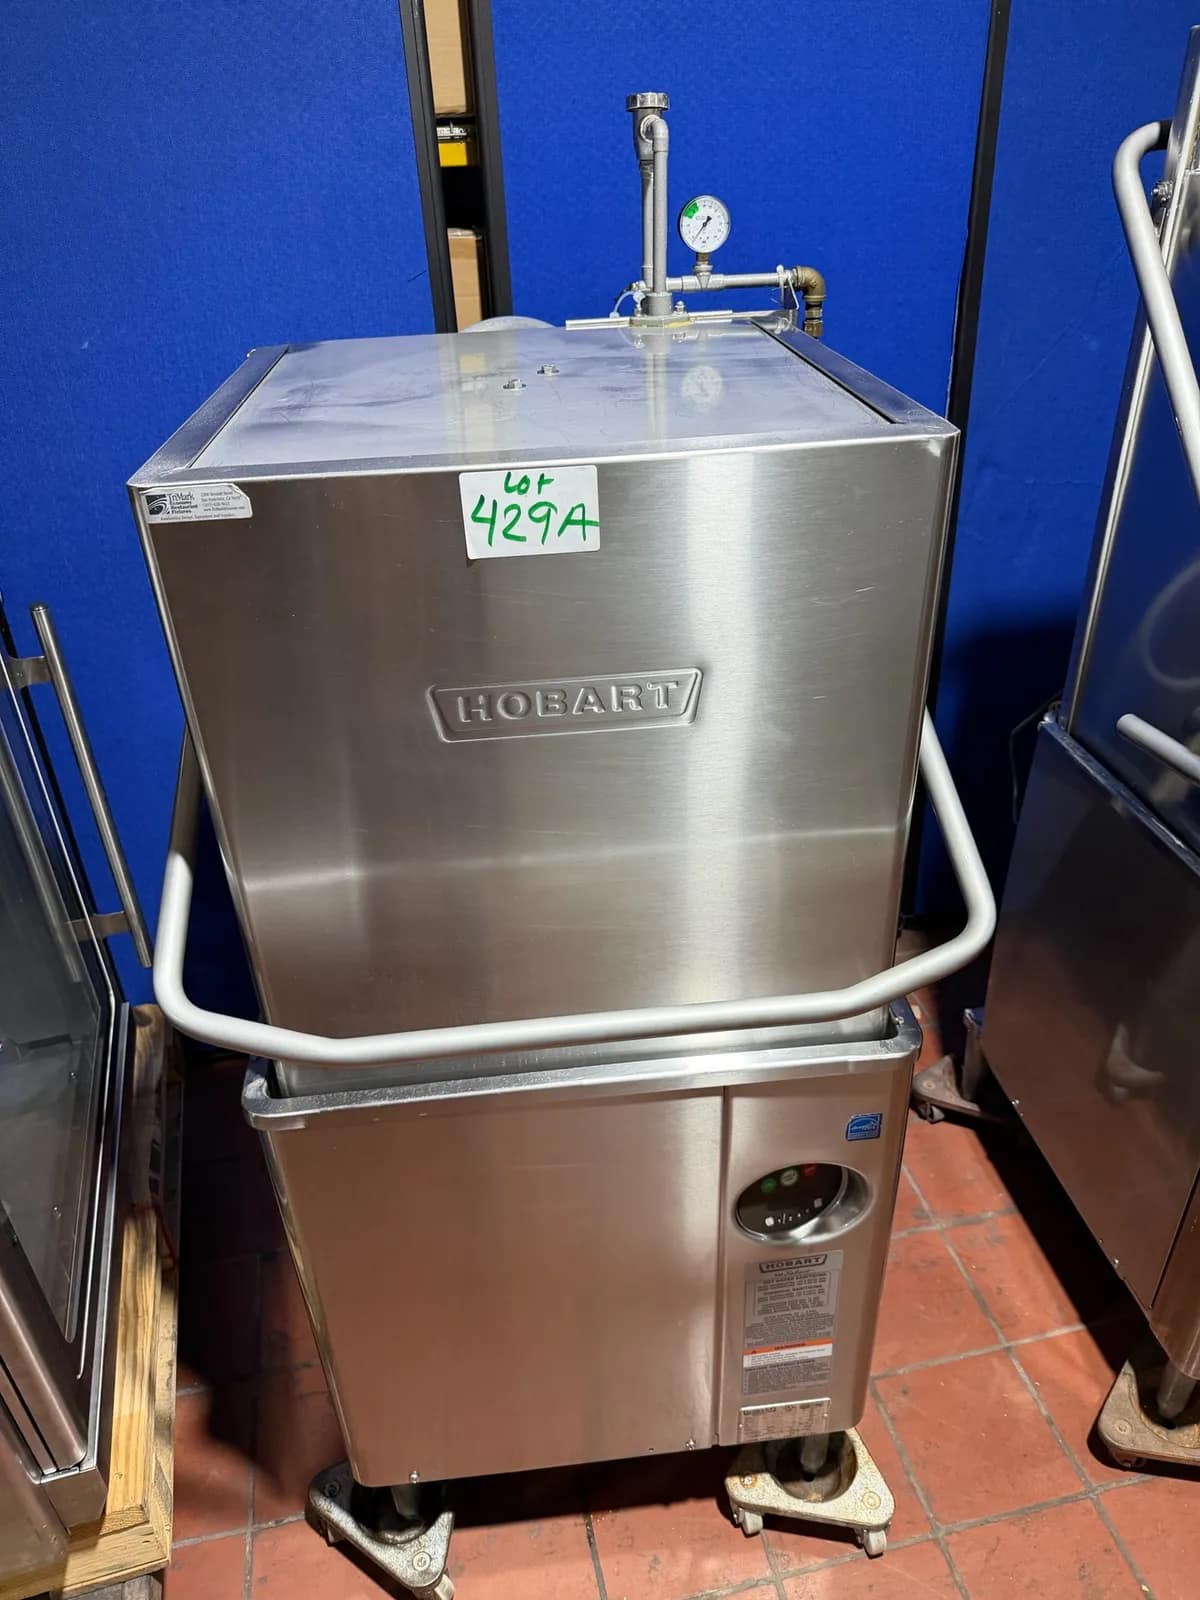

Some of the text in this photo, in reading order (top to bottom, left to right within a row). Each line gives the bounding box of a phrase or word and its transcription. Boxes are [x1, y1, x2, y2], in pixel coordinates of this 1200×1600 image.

[167, 492, 195, 501] TriMark
[471, 494, 600, 547] 429A
[458, 681, 679, 722] HOBART
[766, 1257, 821, 1269] HOBART
